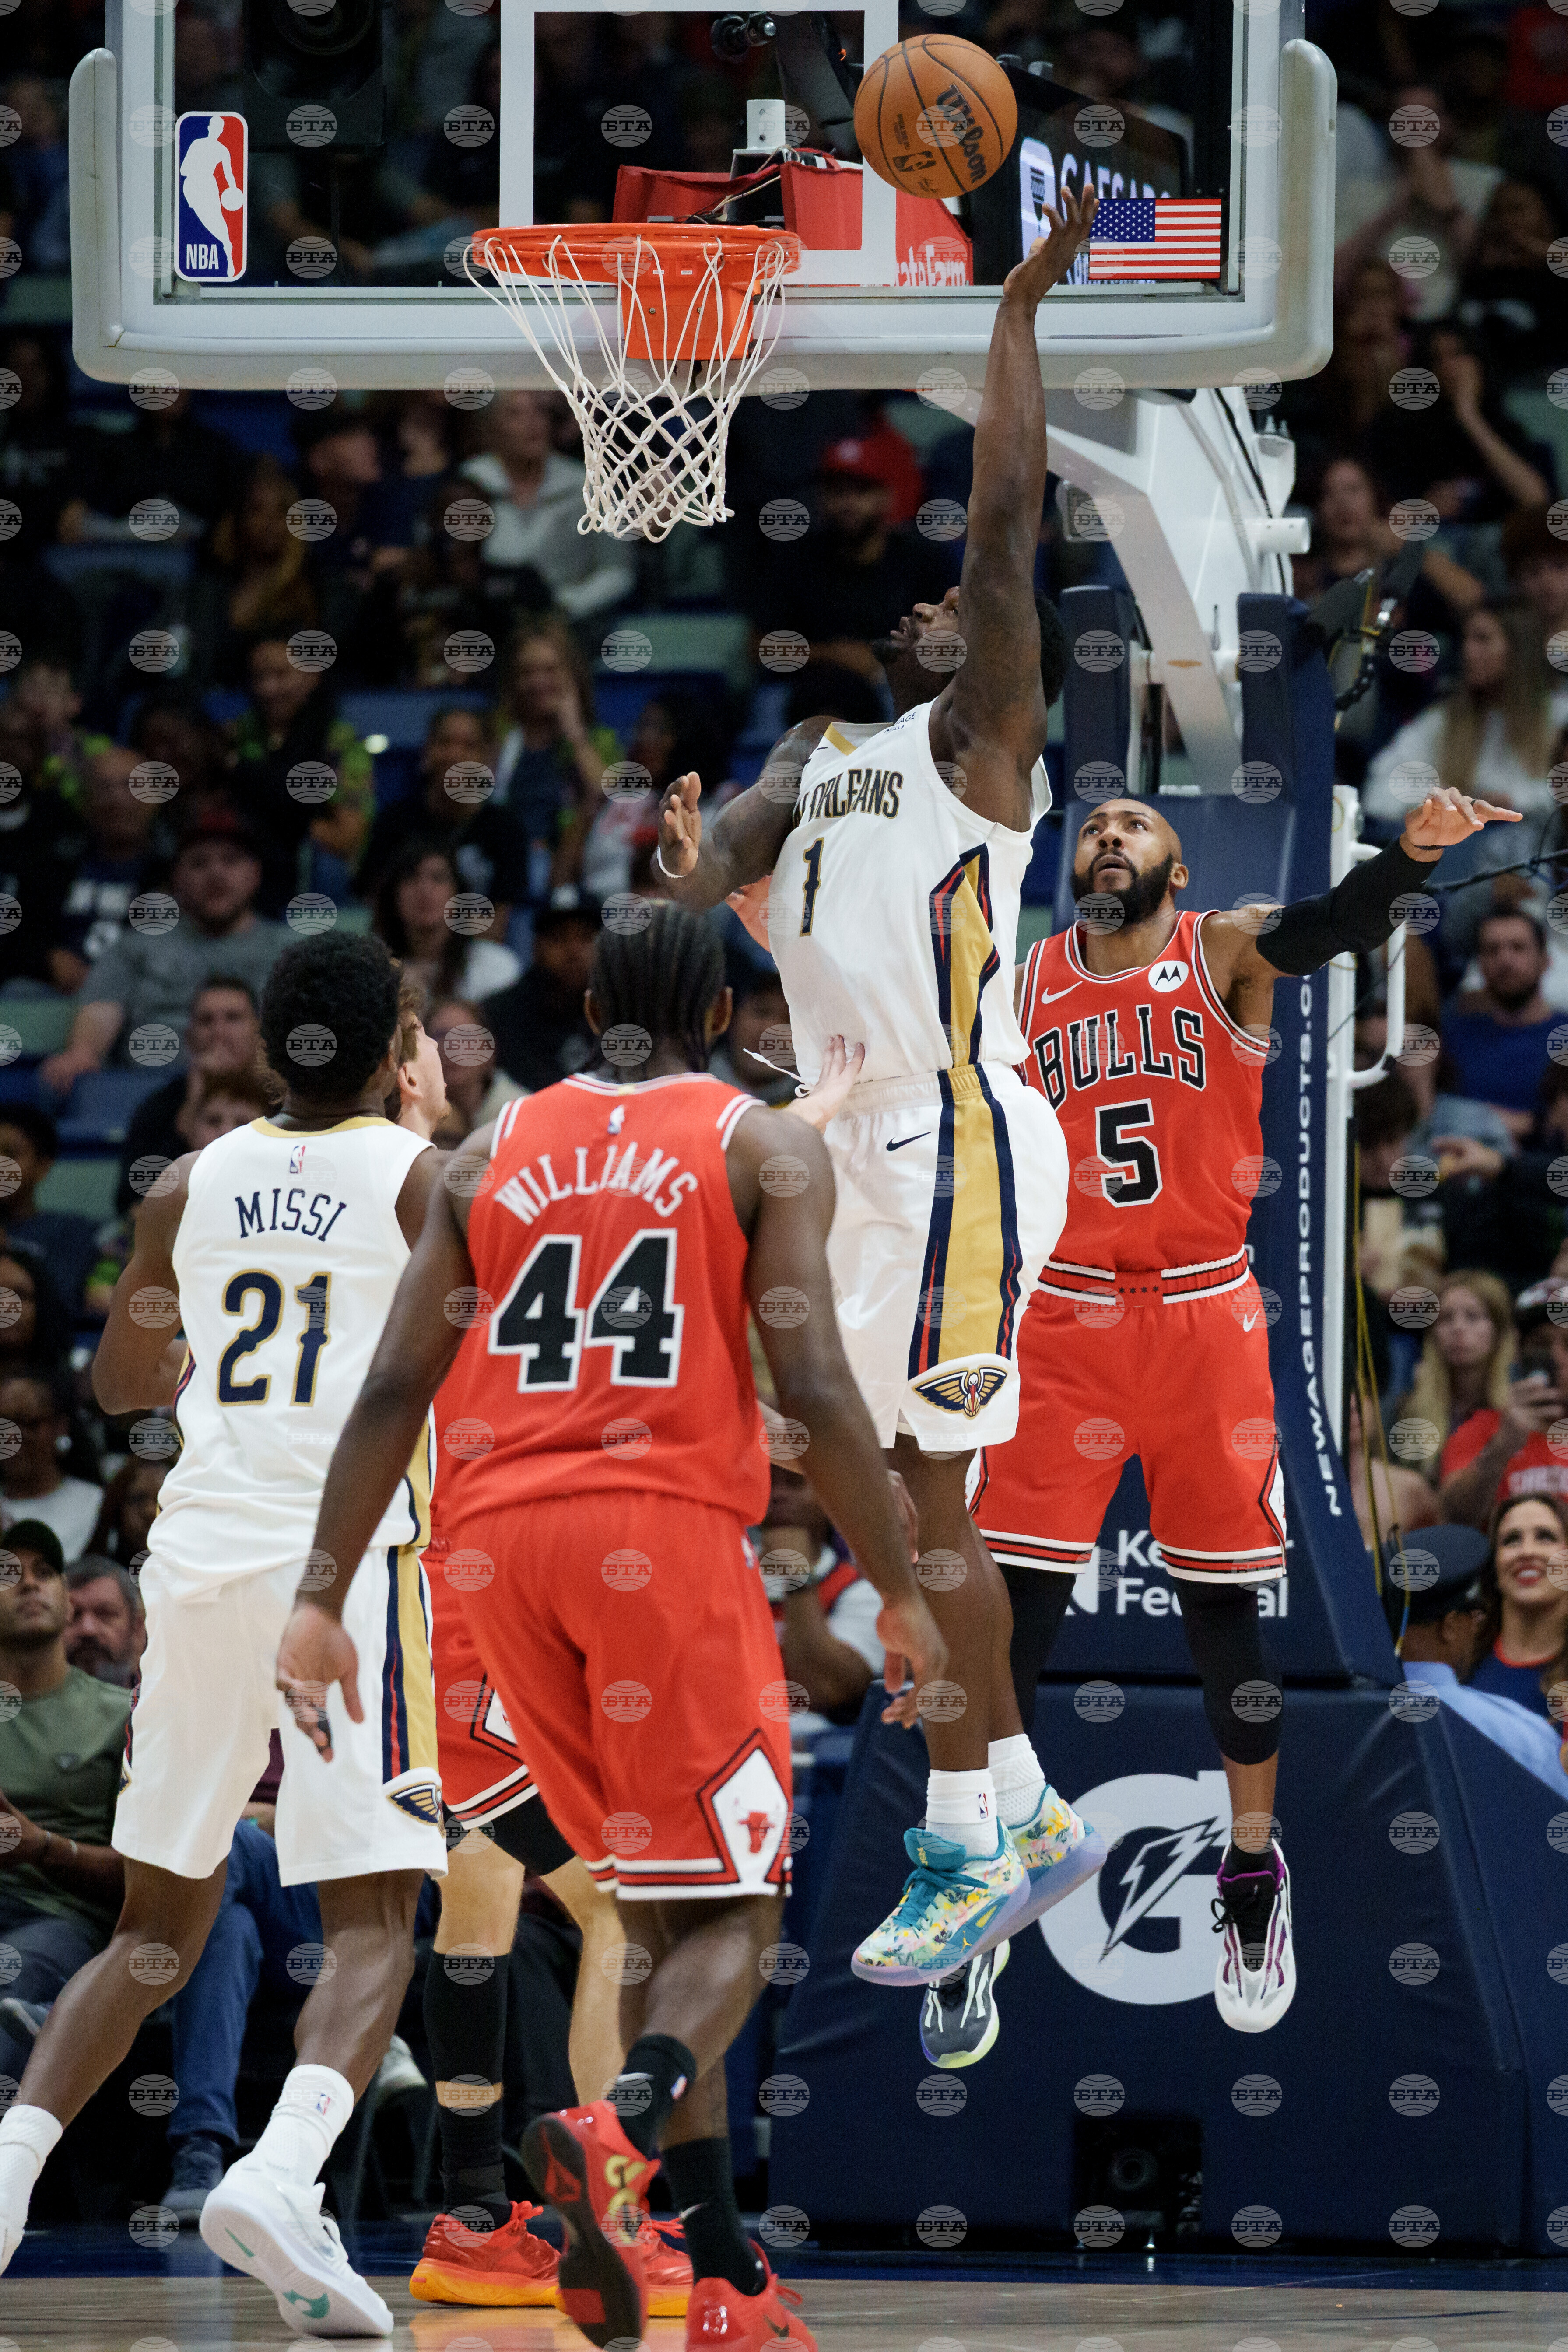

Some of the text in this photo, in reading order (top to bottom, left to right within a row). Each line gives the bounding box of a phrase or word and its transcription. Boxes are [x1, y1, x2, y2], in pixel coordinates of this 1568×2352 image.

[936, 83, 987, 184] Wilson
[186, 244, 219, 270] NBA
[808, 768, 904, 823] ORLEANS
[799, 837, 825, 937] 1
[1032, 1003, 1207, 1113] BULLS
[494, 1141, 698, 1226] WILLIAMS
[1095, 1098, 1163, 1208] 5
[235, 1188, 347, 1242] MISSI
[1298, 975, 1342, 1517] NEWAGEPRODUCTS.C
[216, 1268, 332, 1408] 21
[488, 1227, 684, 1394] 44
